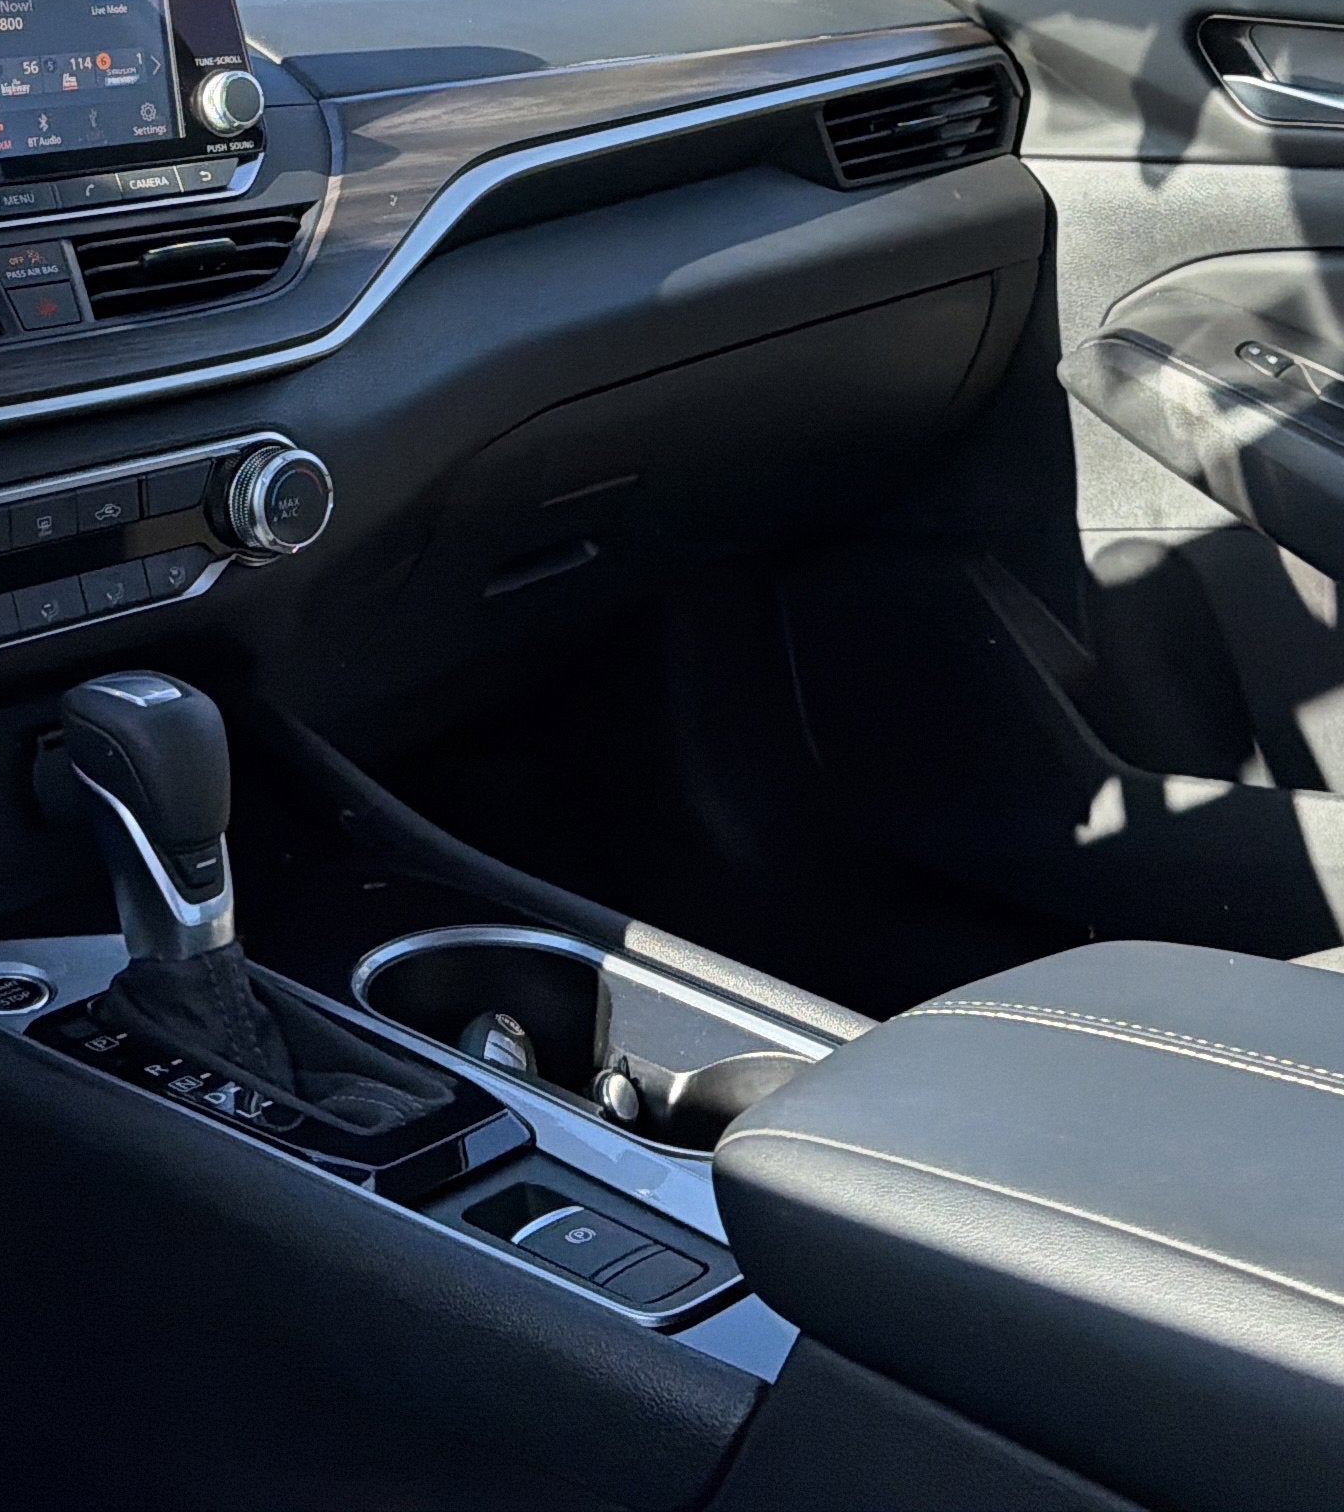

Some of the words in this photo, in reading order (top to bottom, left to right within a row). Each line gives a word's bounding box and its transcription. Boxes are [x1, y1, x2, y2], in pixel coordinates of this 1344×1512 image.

[22, 60, 39, 75] 56
[69, 56, 93, 71] 114
[133, 124, 167, 138] Settings
[27, 138, 38, 148] BT
[39, 134, 62, 146] Audio
[206, 142, 228, 153] PUSH
[229, 140, 255, 151] SOUND
[129, 174, 169, 190] CAMERA
[3, 193, 35, 207] MENU
[278, 497, 300, 510] MAX
[281, 508, 299, 520] A/C
[144, 1064, 169, 1077] R
[204, 1092, 226, 1105] D
